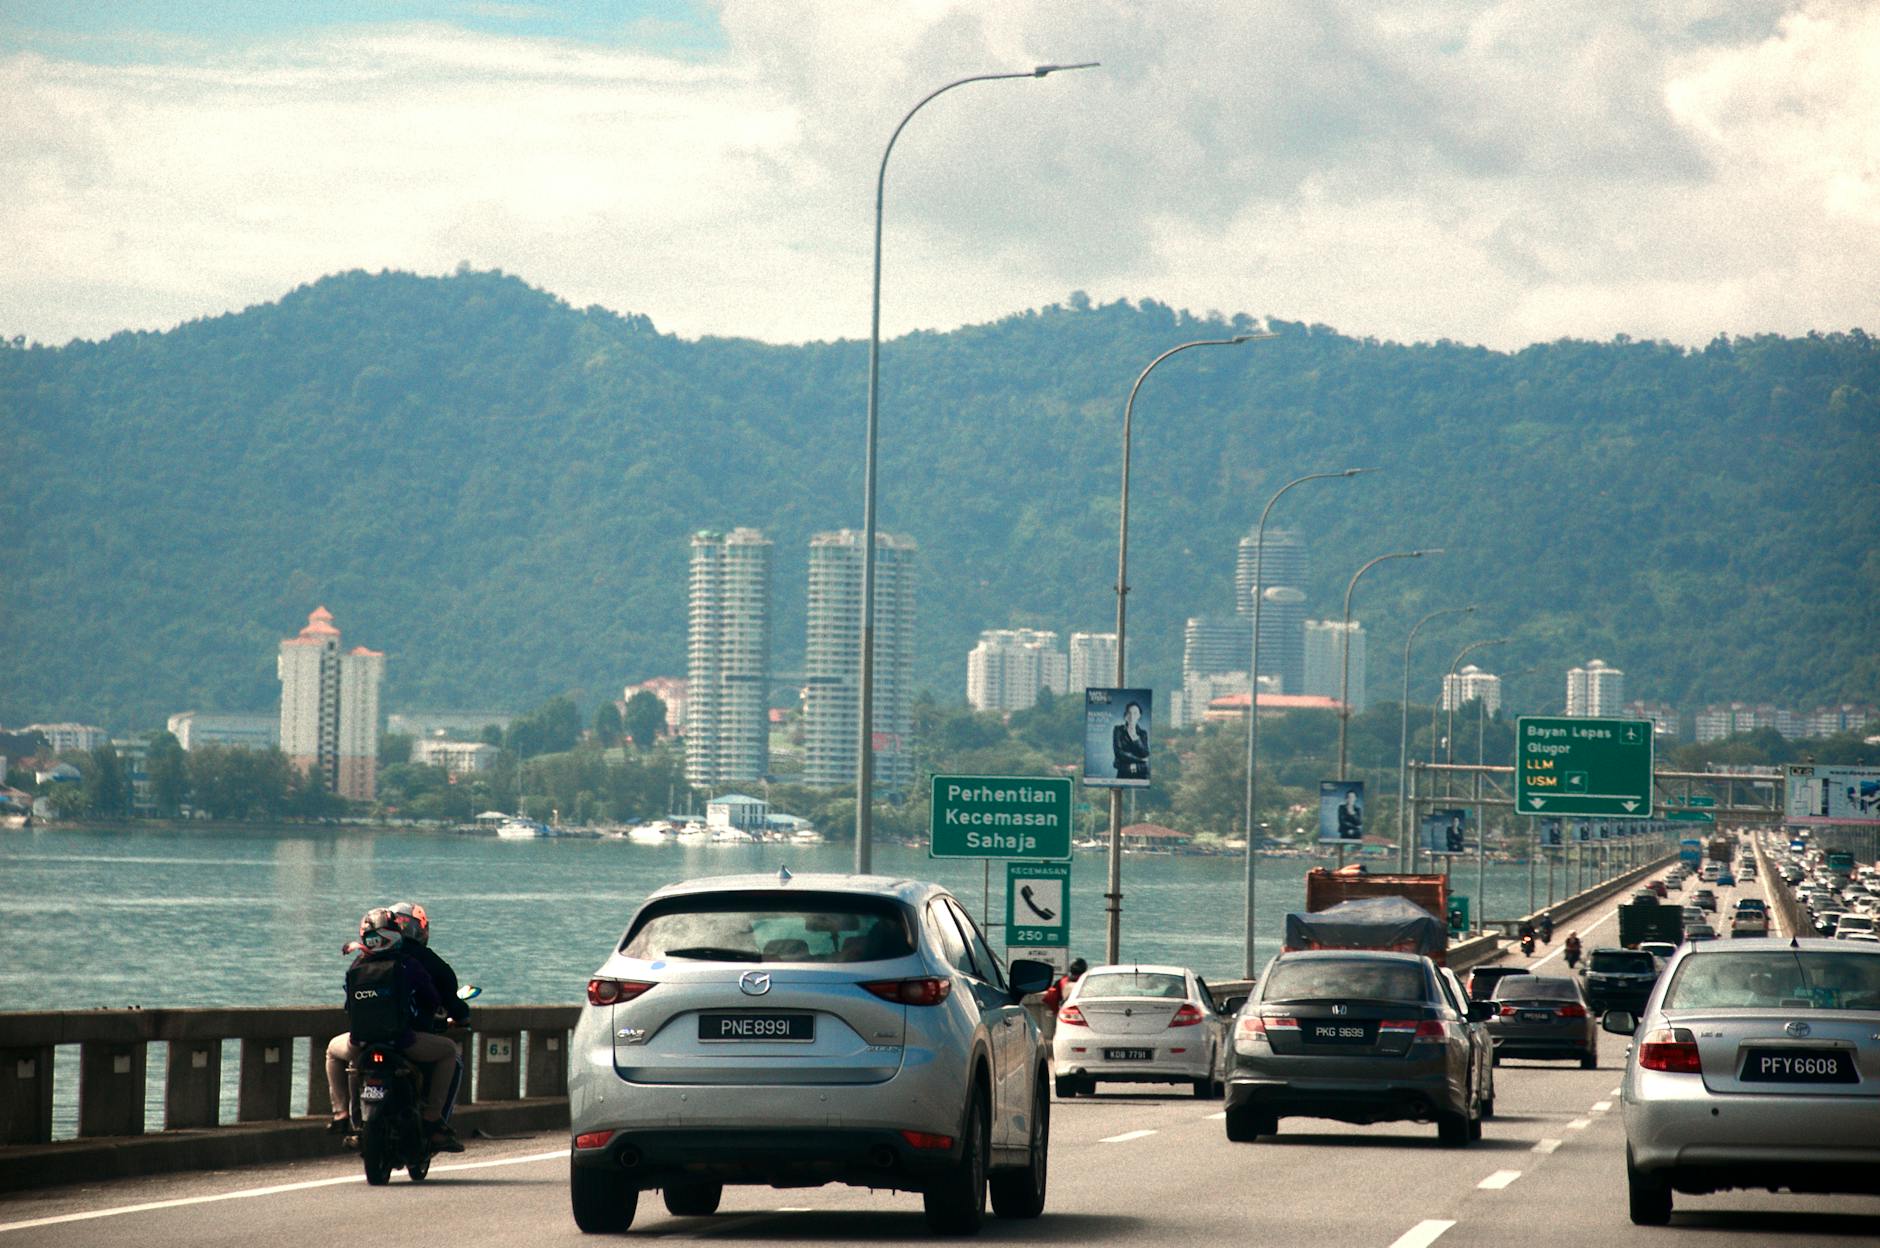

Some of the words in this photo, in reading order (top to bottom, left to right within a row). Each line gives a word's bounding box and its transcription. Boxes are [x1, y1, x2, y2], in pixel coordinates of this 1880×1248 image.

[1527, 725, 1567, 739] Bayan
[1572, 726, 1612, 740] Lepas
[1527, 742, 1571, 756] Glugor
[1526, 759, 1554, 770] LLM
[1526, 776, 1557, 787] USM
[948, 785, 1057, 803] Perhentian
[945, 808, 1058, 827] Kecemasan
[966, 832, 1037, 853] Sahaja
[1010, 867, 1068, 876] KECEMASAN
[1017, 930, 1043, 941] 250
[1047, 933, 1059, 941] m
[721, 1019, 790, 1036] PNE8991
[1315, 1026, 1336, 1038] PKG
[1339, 1027, 1365, 1038] 9699
[489, 1043, 510, 1056] 6.5
[1760, 1056, 1838, 1075] PFY6608
